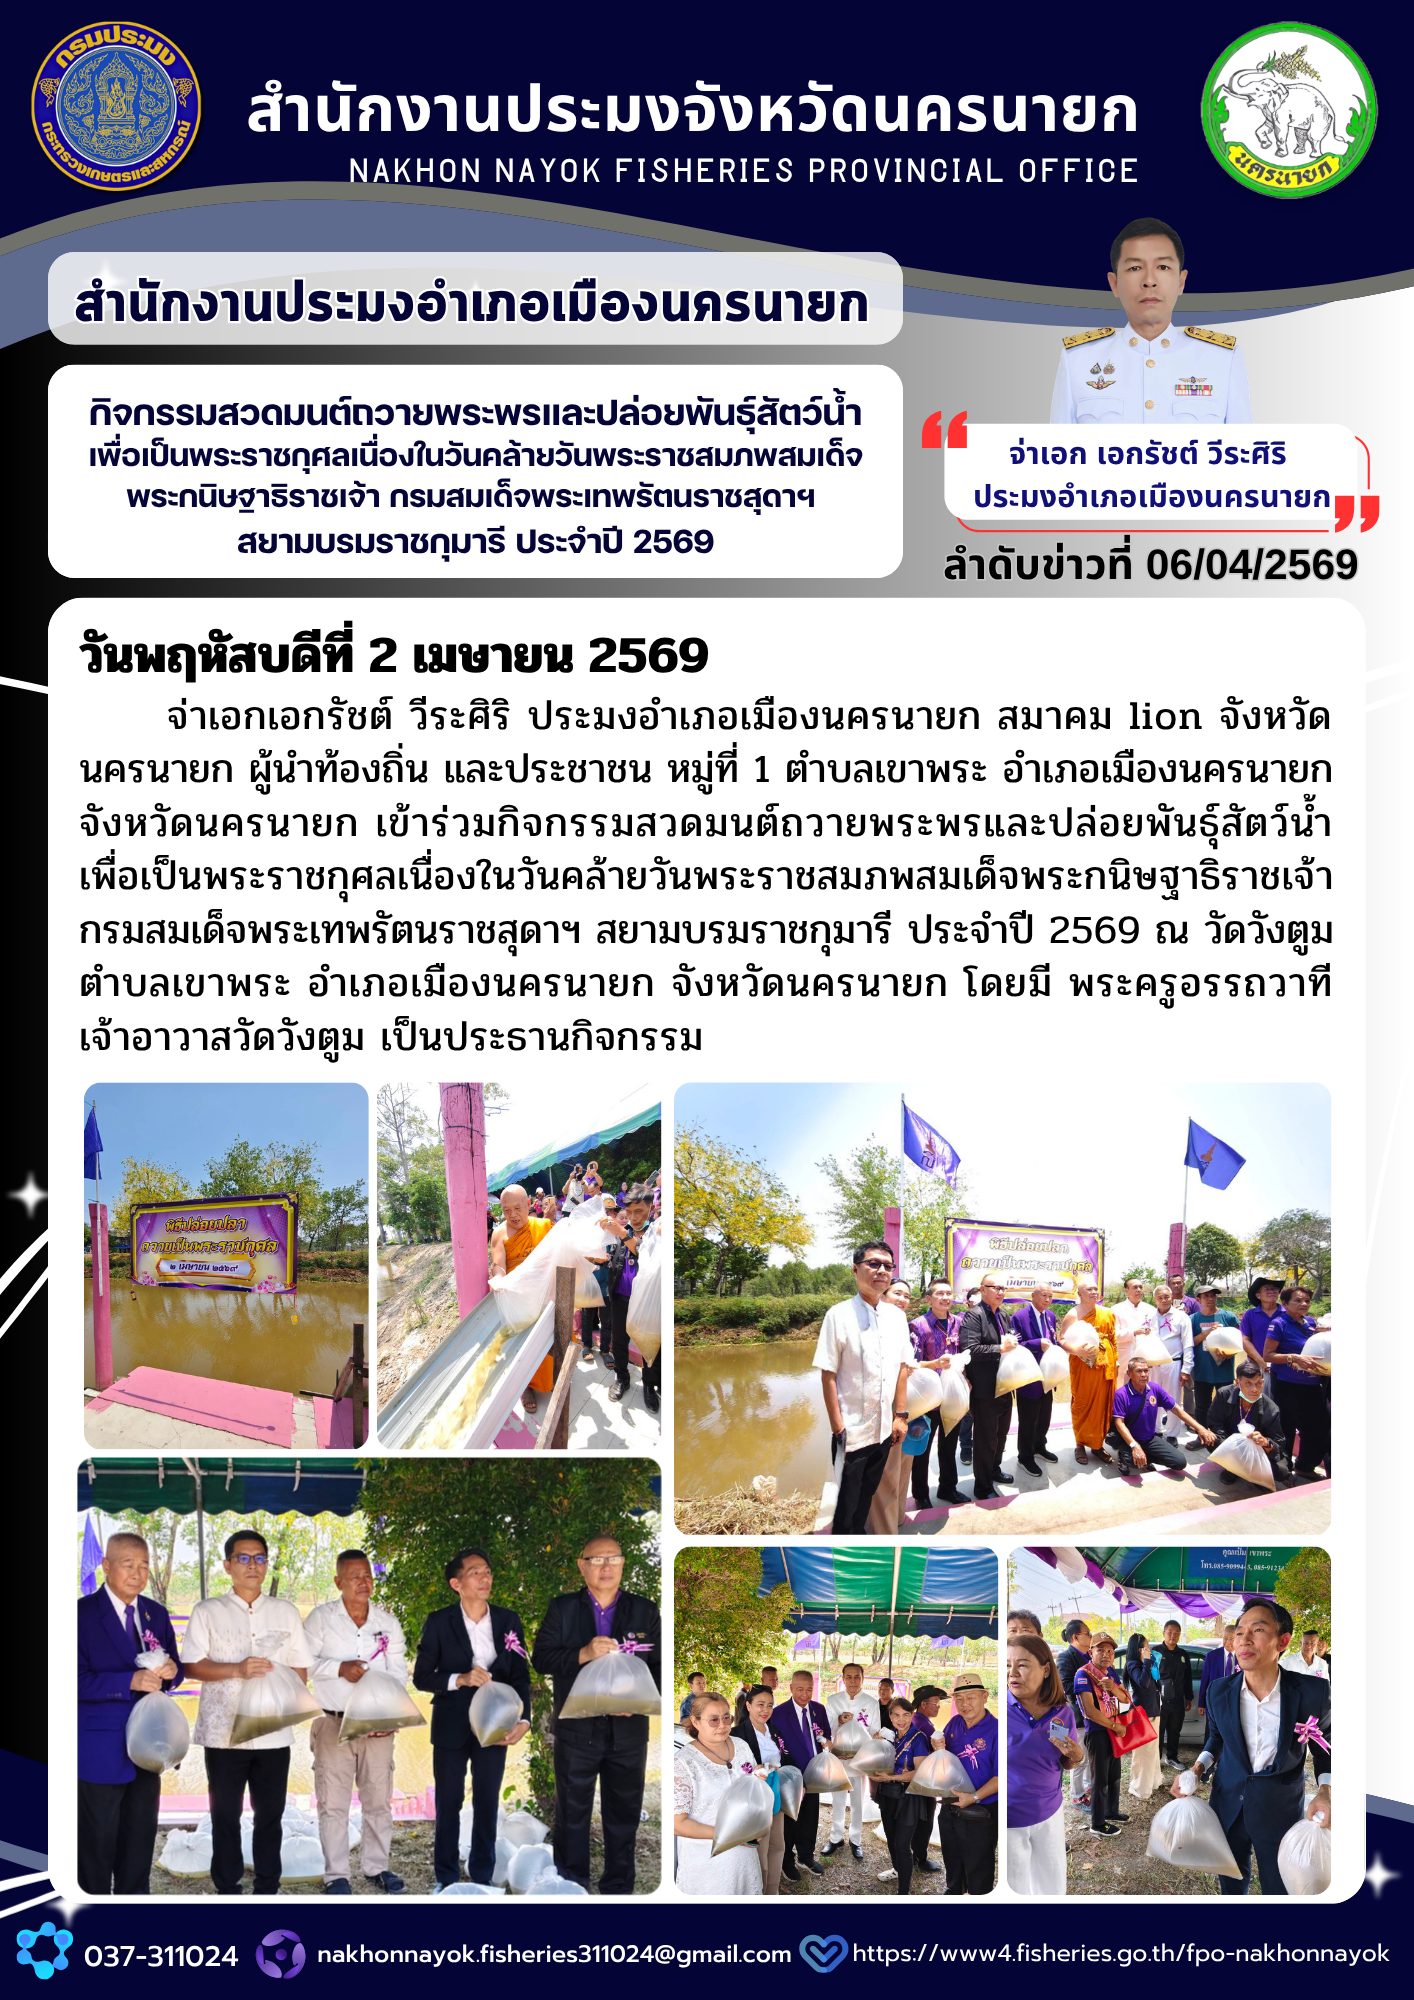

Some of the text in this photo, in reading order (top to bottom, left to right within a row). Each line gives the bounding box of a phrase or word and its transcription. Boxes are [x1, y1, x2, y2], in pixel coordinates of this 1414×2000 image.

[165, 1215, 248, 1233] พิธีปล่อยปลา
[179, 1263, 210, 1271] เมษายน
